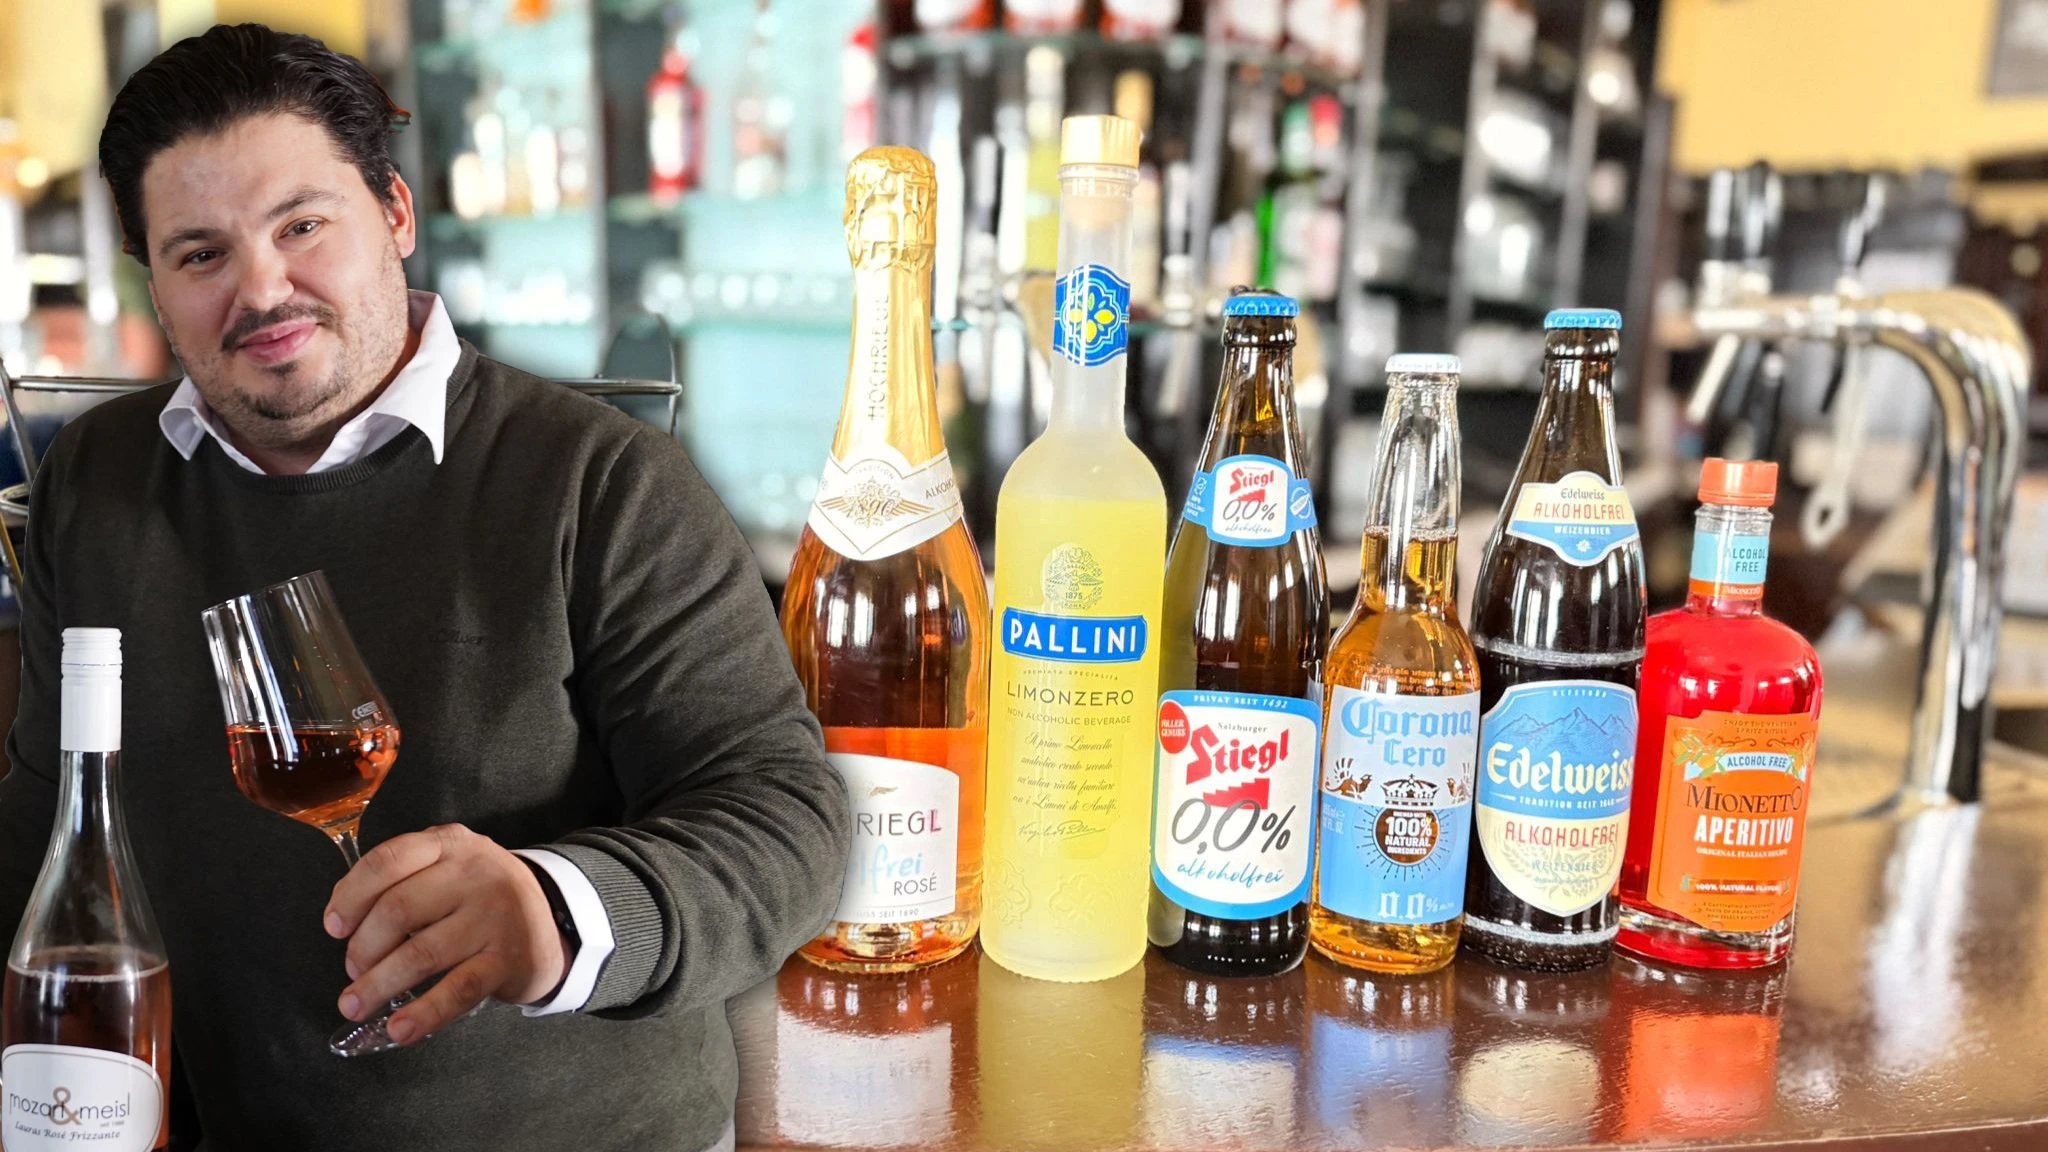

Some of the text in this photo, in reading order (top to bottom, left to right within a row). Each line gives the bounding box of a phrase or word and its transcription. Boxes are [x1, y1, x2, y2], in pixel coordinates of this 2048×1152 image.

[1229, 468, 1275, 494] Stiegl
[1560, 488, 1606, 500] Edelweiss
[1222, 499, 1278, 522] 0,0%
[1533, 502, 1625, 520] ALKOHOLFREI
[1553, 525, 1612, 536] WEIZENBIER
[1735, 561, 1760, 573] FREE
[1065, 591, 1083, 600] 1875
[1010, 617, 1137, 654] PALLINI
[1007, 680, 1134, 706] LIMONZERO
[1193, 694, 1289, 709] PRIVAT SEIT 1492
[1007, 707, 1132, 726] NON ALCOHOLIC BEVERAGE
[1161, 719, 1185, 728] VOLLER
[1341, 696, 1472, 745] Corona
[1186, 724, 1290, 785] Stiegl
[1383, 738, 1446, 767] Cero
[1727, 755, 1789, 769] ALCOHOL FREE
[1486, 741, 1635, 795] Edelweiss
[1519, 796, 1573, 809] TRADITION
[1577, 799, 1597, 809] SEIT
[856, 808, 942, 837] RIEGL
[1171, 797, 1297, 855] 0,0%
[1385, 816, 1433, 838] 100%
[1693, 814, 1794, 847] APERITIVO
[1384, 835, 1432, 848] NATURAL
[1505, 820, 1619, 848] ALKOHOLFREI
[893, 872, 938, 896] ROSÉ
[1177, 858, 1286, 889] alkoholfrei
[1720, 883, 1755, 893] NATURAL
[879, 909, 896, 918] SEIT
[899, 907, 920, 917] 1890
[15, 1120, 121, 1142] Lauras Rosé Frizzante
